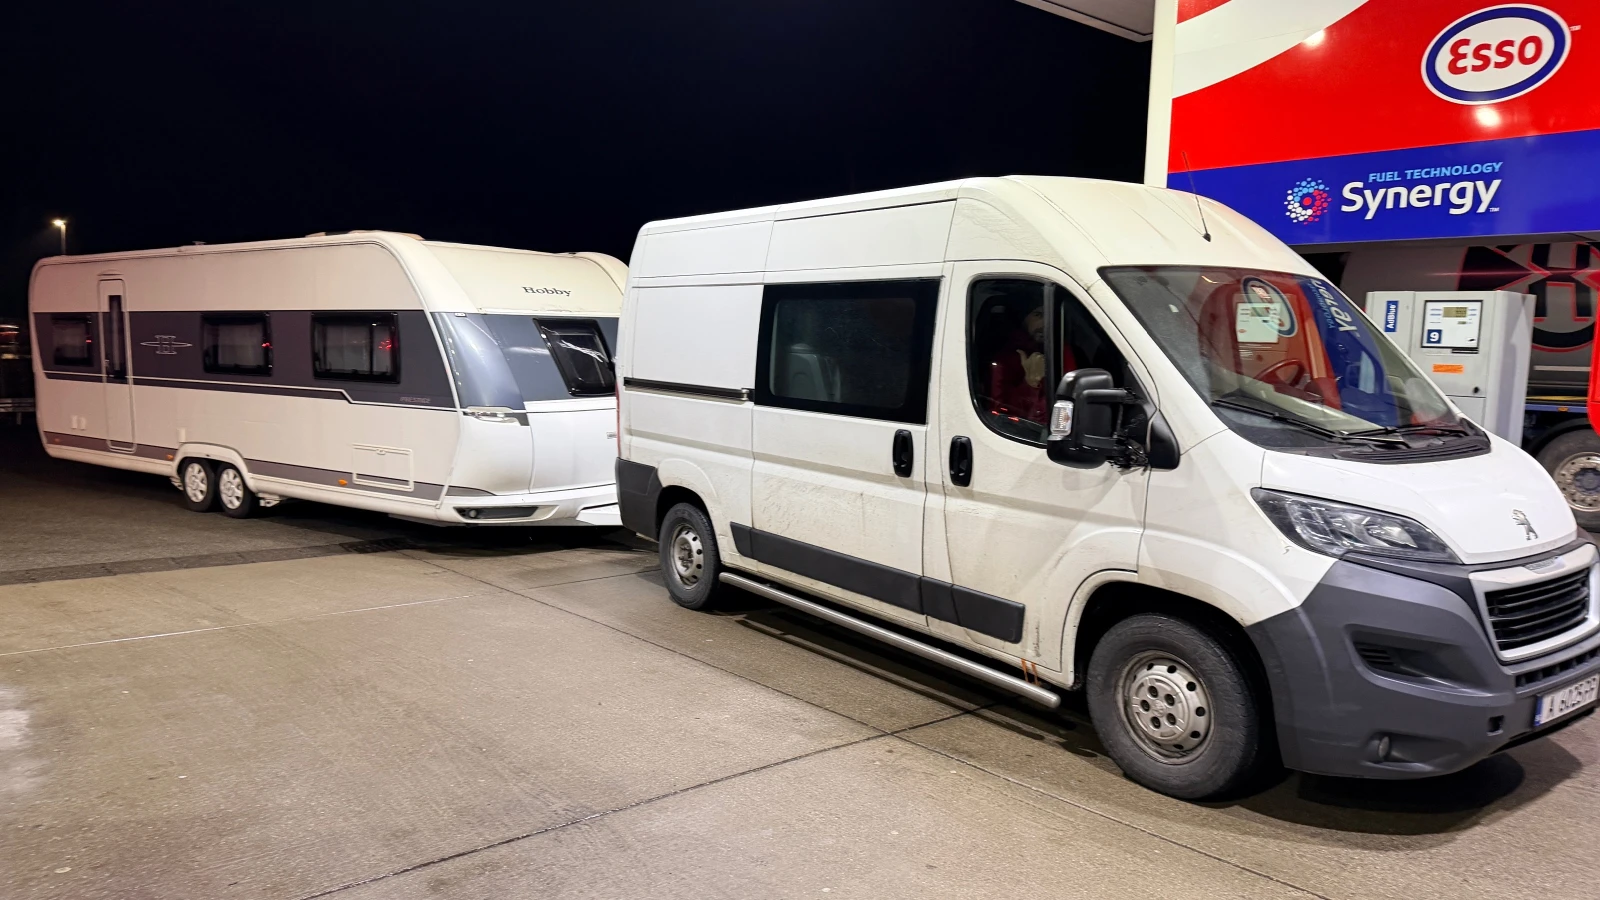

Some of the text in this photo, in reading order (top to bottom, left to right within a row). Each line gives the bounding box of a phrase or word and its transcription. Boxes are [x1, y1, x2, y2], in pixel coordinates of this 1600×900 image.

[1368, 162, 1503, 183] FUEL TECHNOLOGY
[1341, 179, 1502, 220] Synergy
[521, 286, 571, 297] Hobby
[1386, 303, 1397, 329] AdBlue
[1430, 332, 1440, 342] 9
